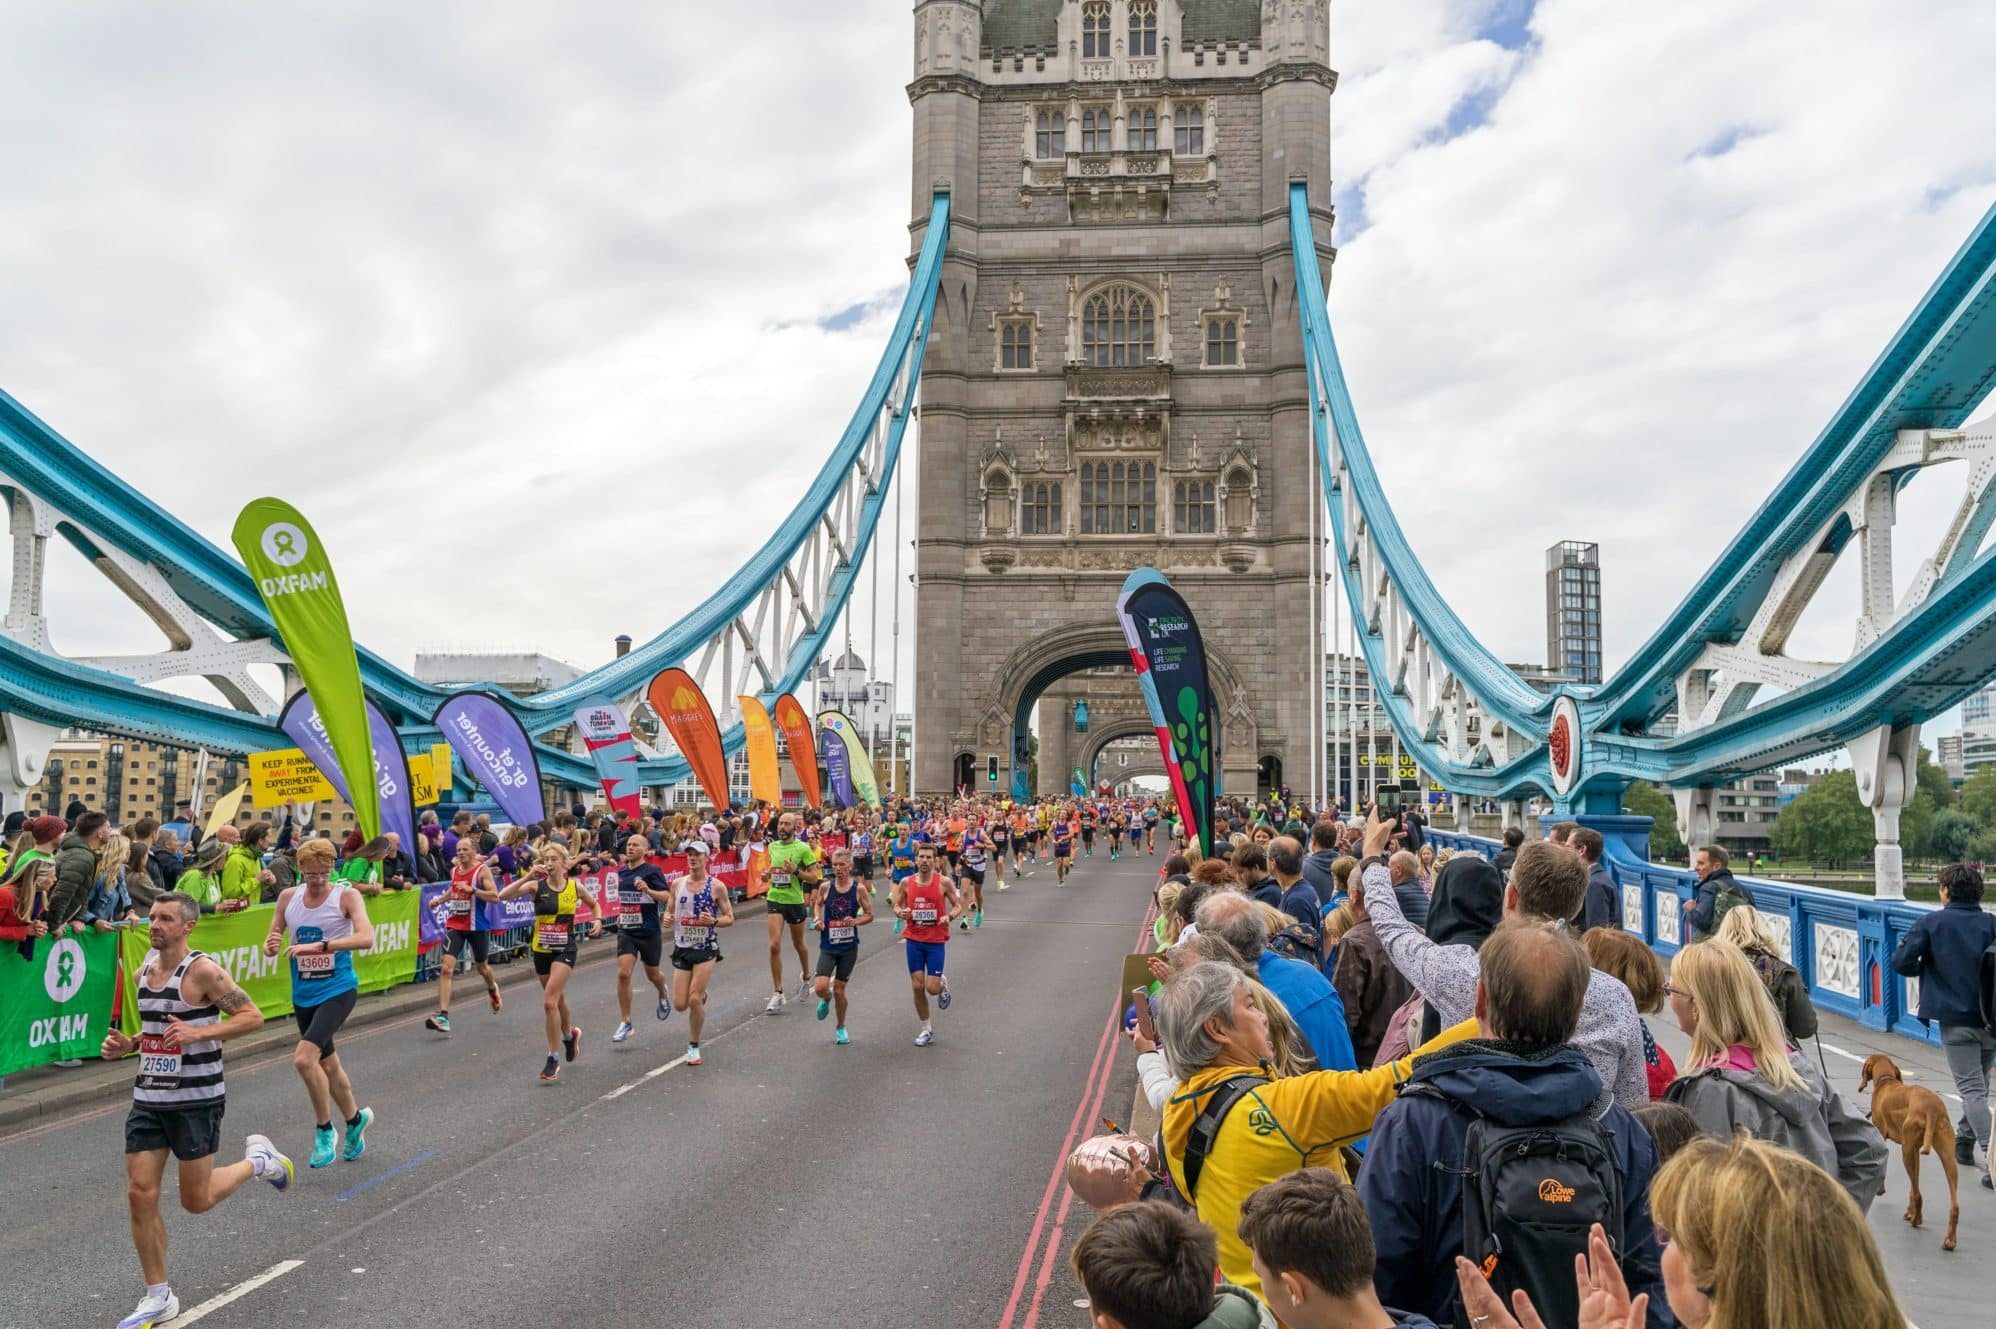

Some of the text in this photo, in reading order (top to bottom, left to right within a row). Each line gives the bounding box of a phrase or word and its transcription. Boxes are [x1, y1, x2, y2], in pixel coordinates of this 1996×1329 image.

[261, 570, 328, 597] OXFAM
[1160, 623, 1188, 631] RESEARCH
[1155, 663, 1179, 671] RESEARCH
[262, 759, 283, 769] KEEP
[269, 766, 317, 778] AWAY FROM
[265, 775, 321, 788] EXPERIMENTAL
[300, 956, 330, 968] 43609
[29, 1012, 89, 1048] OXAM
[143, 1056, 177, 1072] 27590
[1551, 1185, 1576, 1196] Lowe
[1544, 1193, 1571, 1204] alpine
